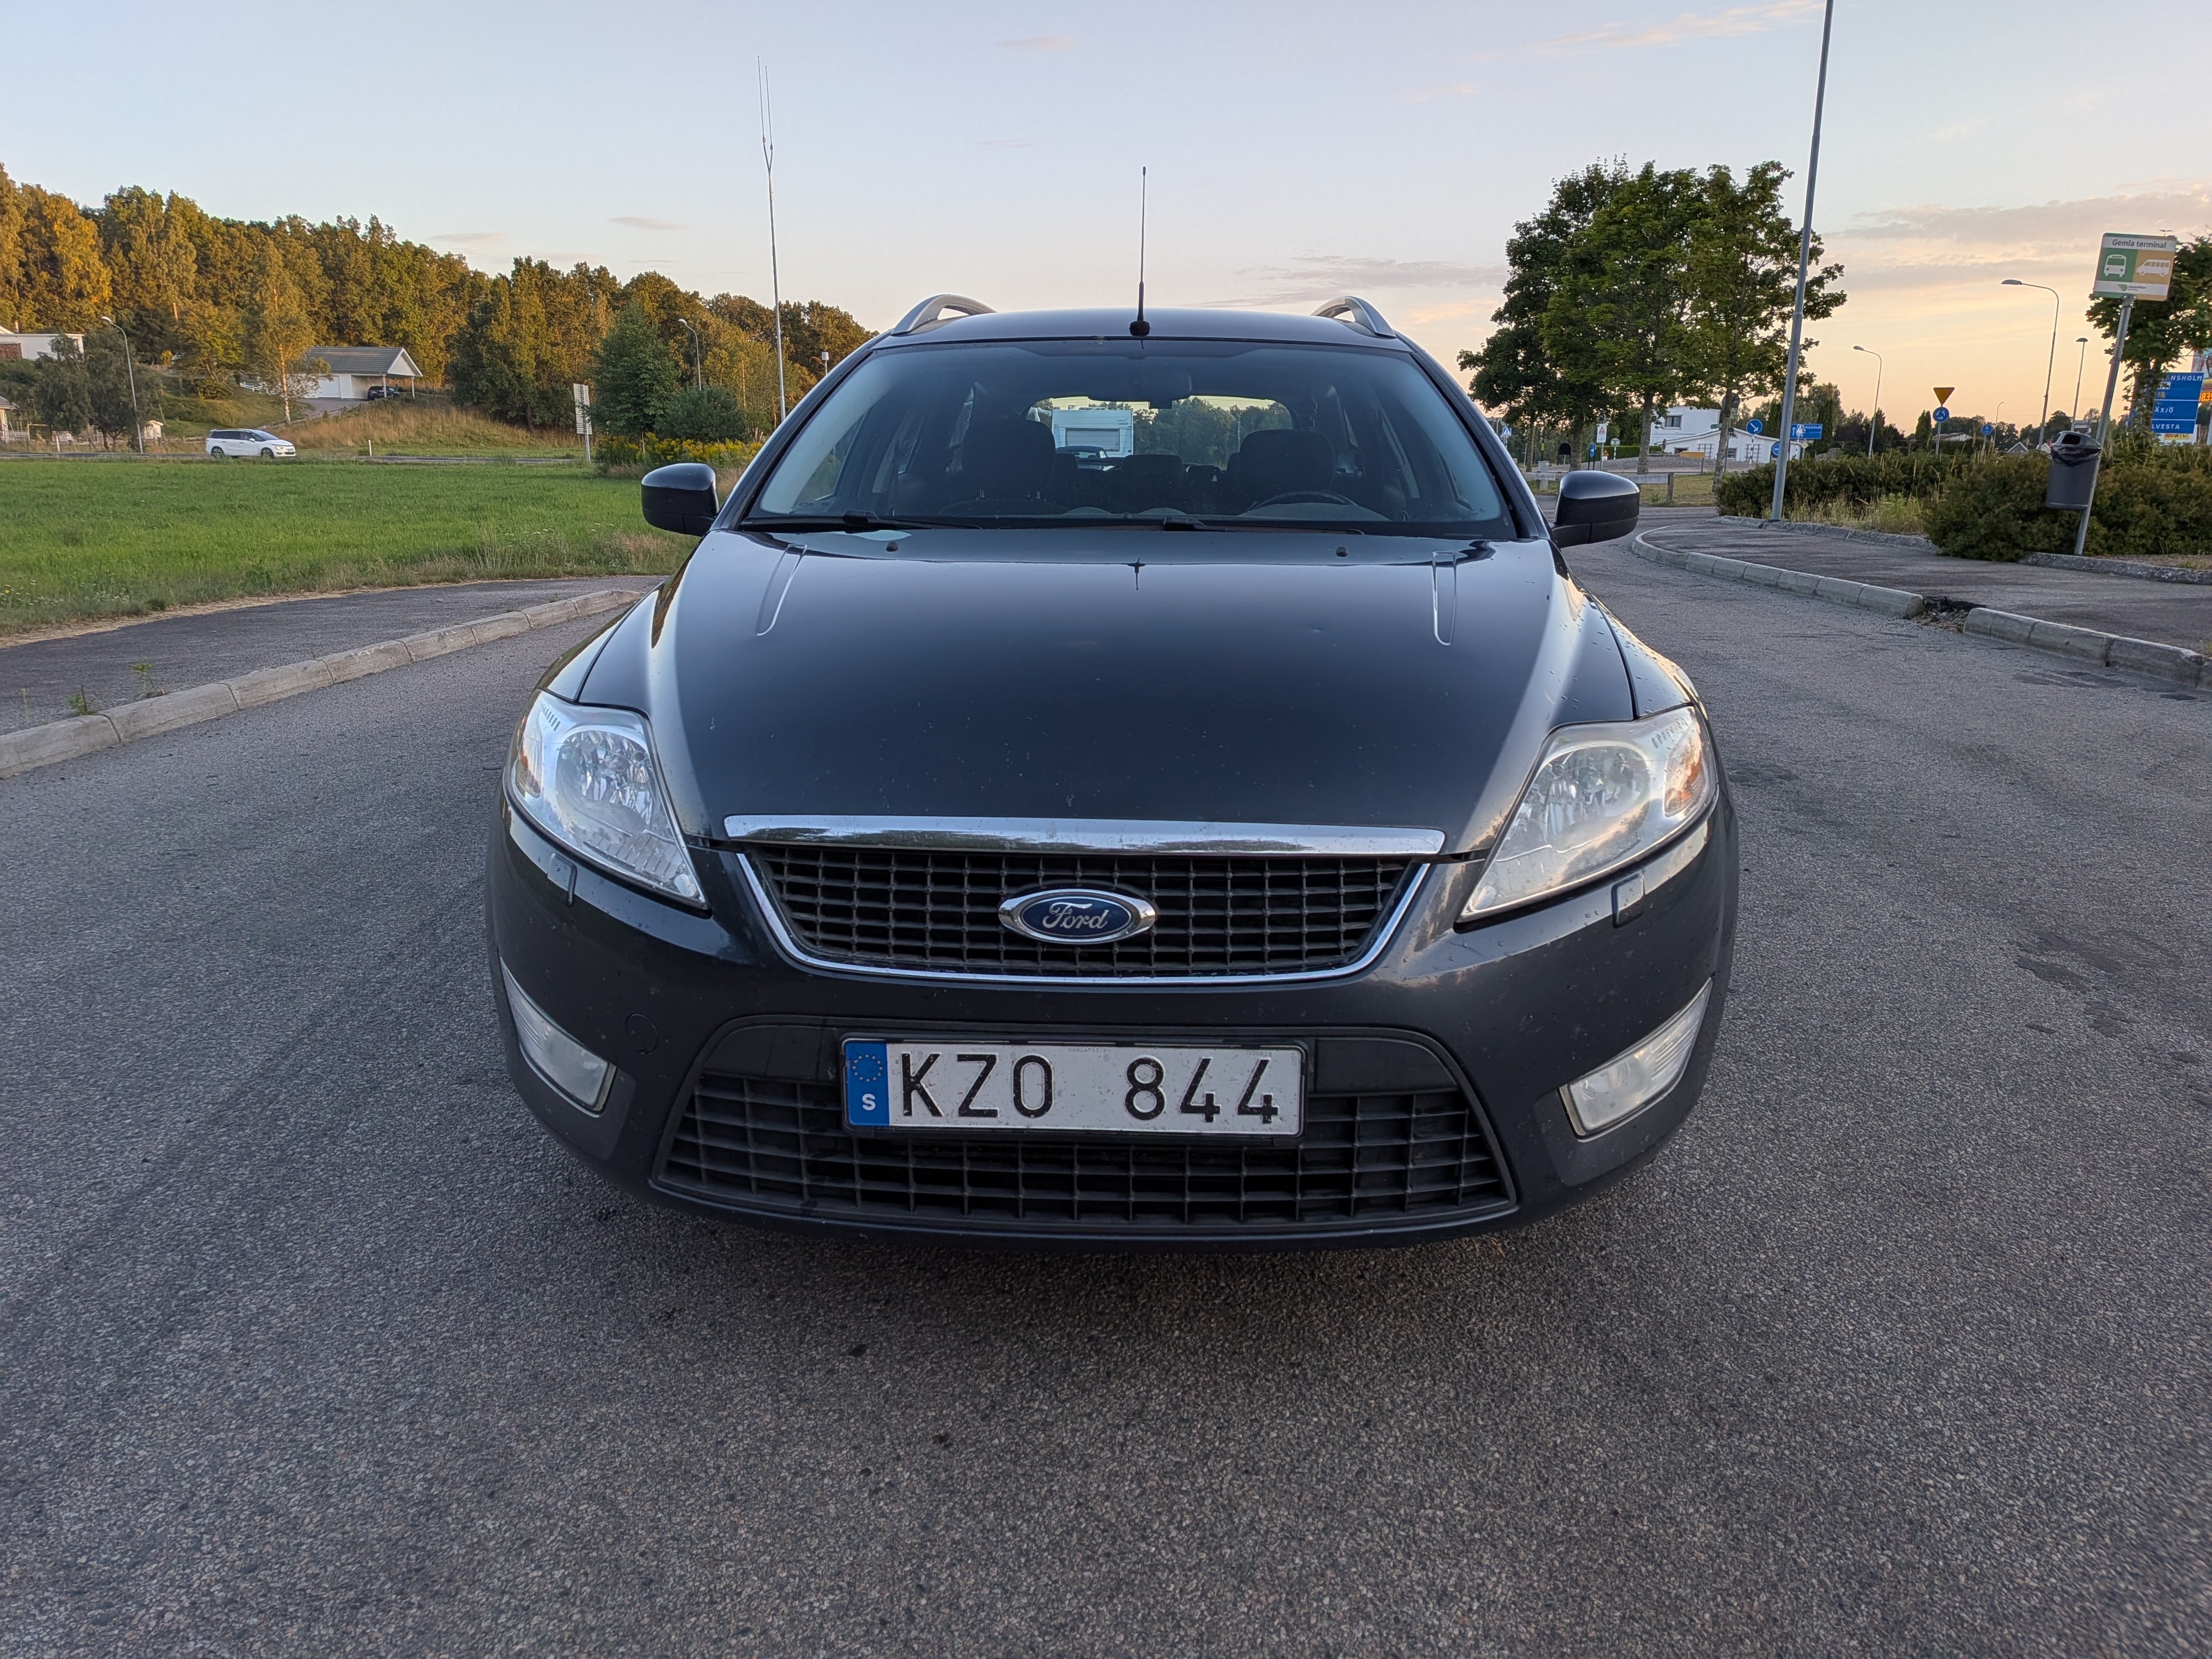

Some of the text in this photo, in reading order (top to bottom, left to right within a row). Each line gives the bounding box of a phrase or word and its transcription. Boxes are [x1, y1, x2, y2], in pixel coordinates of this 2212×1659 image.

[1042, 901, 1110, 930] Ford
[862, 1093, 876, 1111] S
[901, 1052, 1280, 1124] KZO 844
